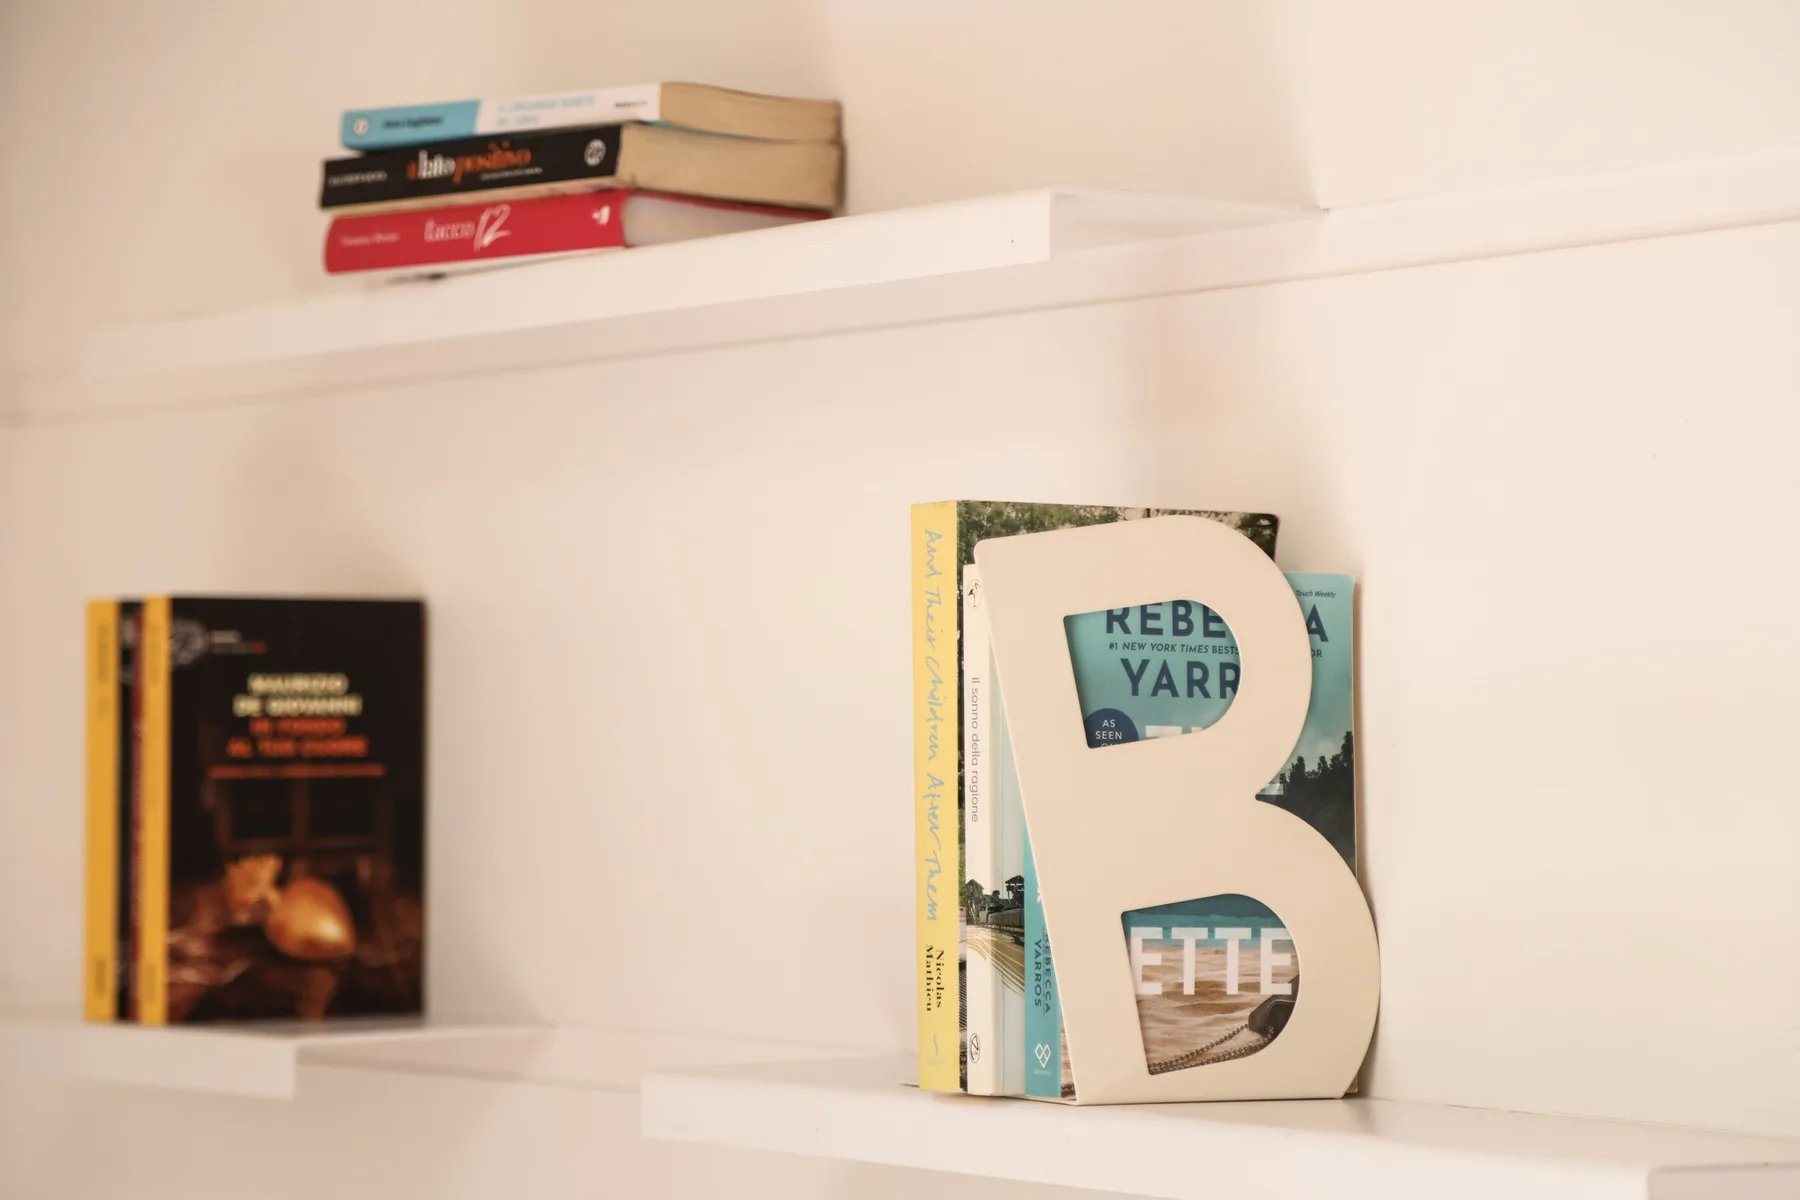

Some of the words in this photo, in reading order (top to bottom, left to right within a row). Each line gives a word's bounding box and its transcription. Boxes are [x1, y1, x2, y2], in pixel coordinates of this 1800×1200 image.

[924, 529, 943, 578] And
[924, 586, 944, 651] Their
[1295, 589, 1313, 598] Touch
[1314, 590, 1337, 599] Weekly
[1108, 642, 1118, 651] #1
[1122, 642, 1147, 651] NEW
[1150, 643, 1177, 653] YORK
[1180, 644, 1209, 654] TIMES
[1120, 658, 1240, 699] YARR
[925, 655, 946, 761] Children
[971, 687, 979, 729] sonno
[1102, 719, 1116, 728] AS
[971, 733, 980, 766] della
[1095, 731, 1122, 740] SEEN
[922, 772, 945, 850] After
[969, 770, 980, 823] ragione
[924, 850, 942, 921] Them
[926, 944, 934, 1012] Mathieu
[935, 949, 945, 1009] Nicolas
[1034, 939, 1042, 1007] YARROS
[1131, 927, 1293, 996] ETTE
